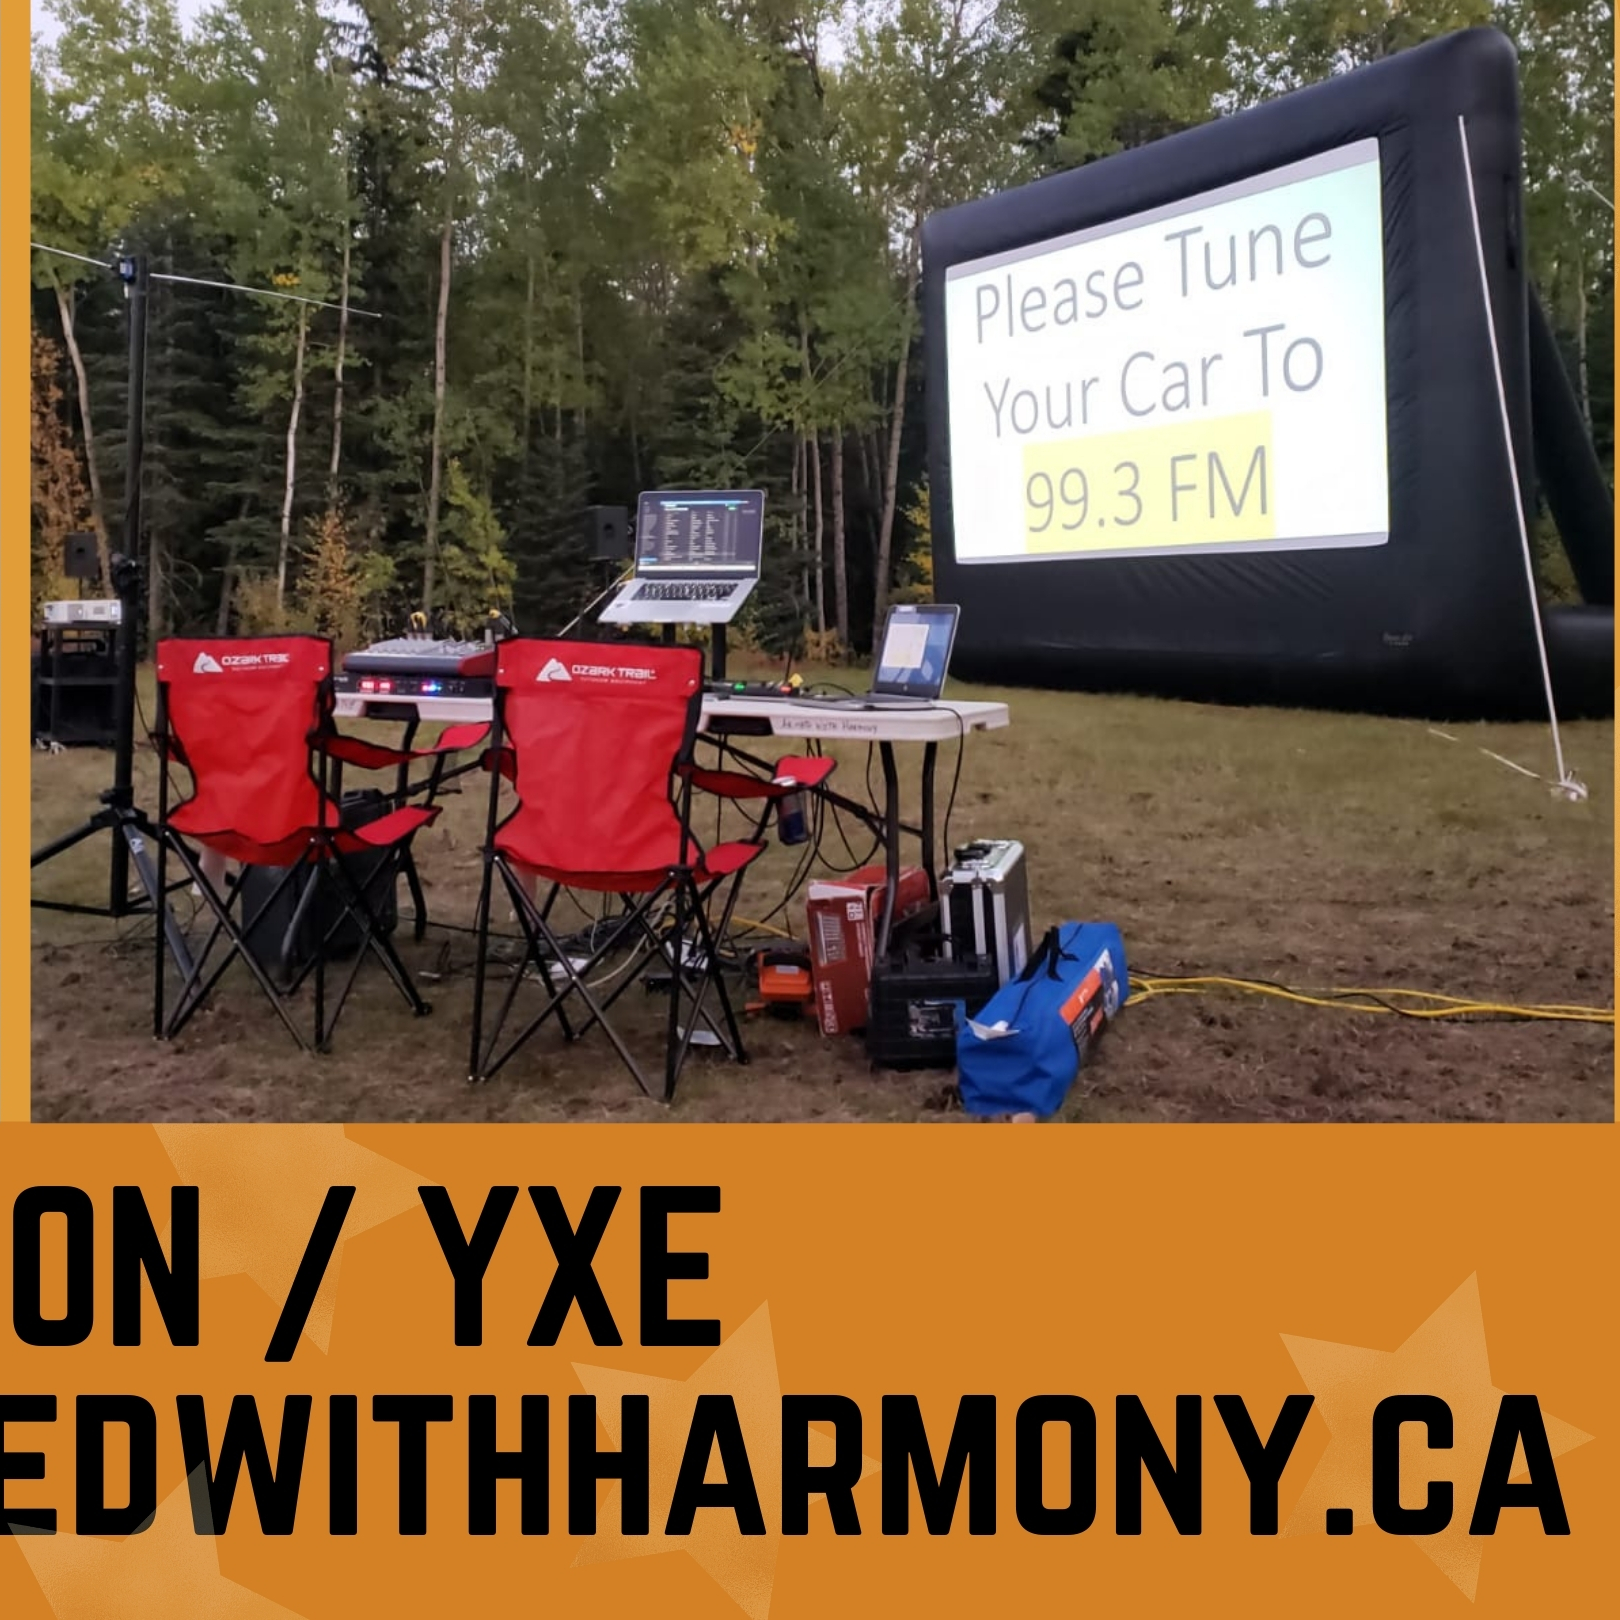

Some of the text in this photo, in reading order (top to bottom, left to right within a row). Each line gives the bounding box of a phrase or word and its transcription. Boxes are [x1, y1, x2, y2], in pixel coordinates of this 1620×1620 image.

[976, 212, 1333, 344] Please Tune
[984, 324, 1323, 438] Your Car To
[1027, 446, 1268, 533] 99.3 FM
